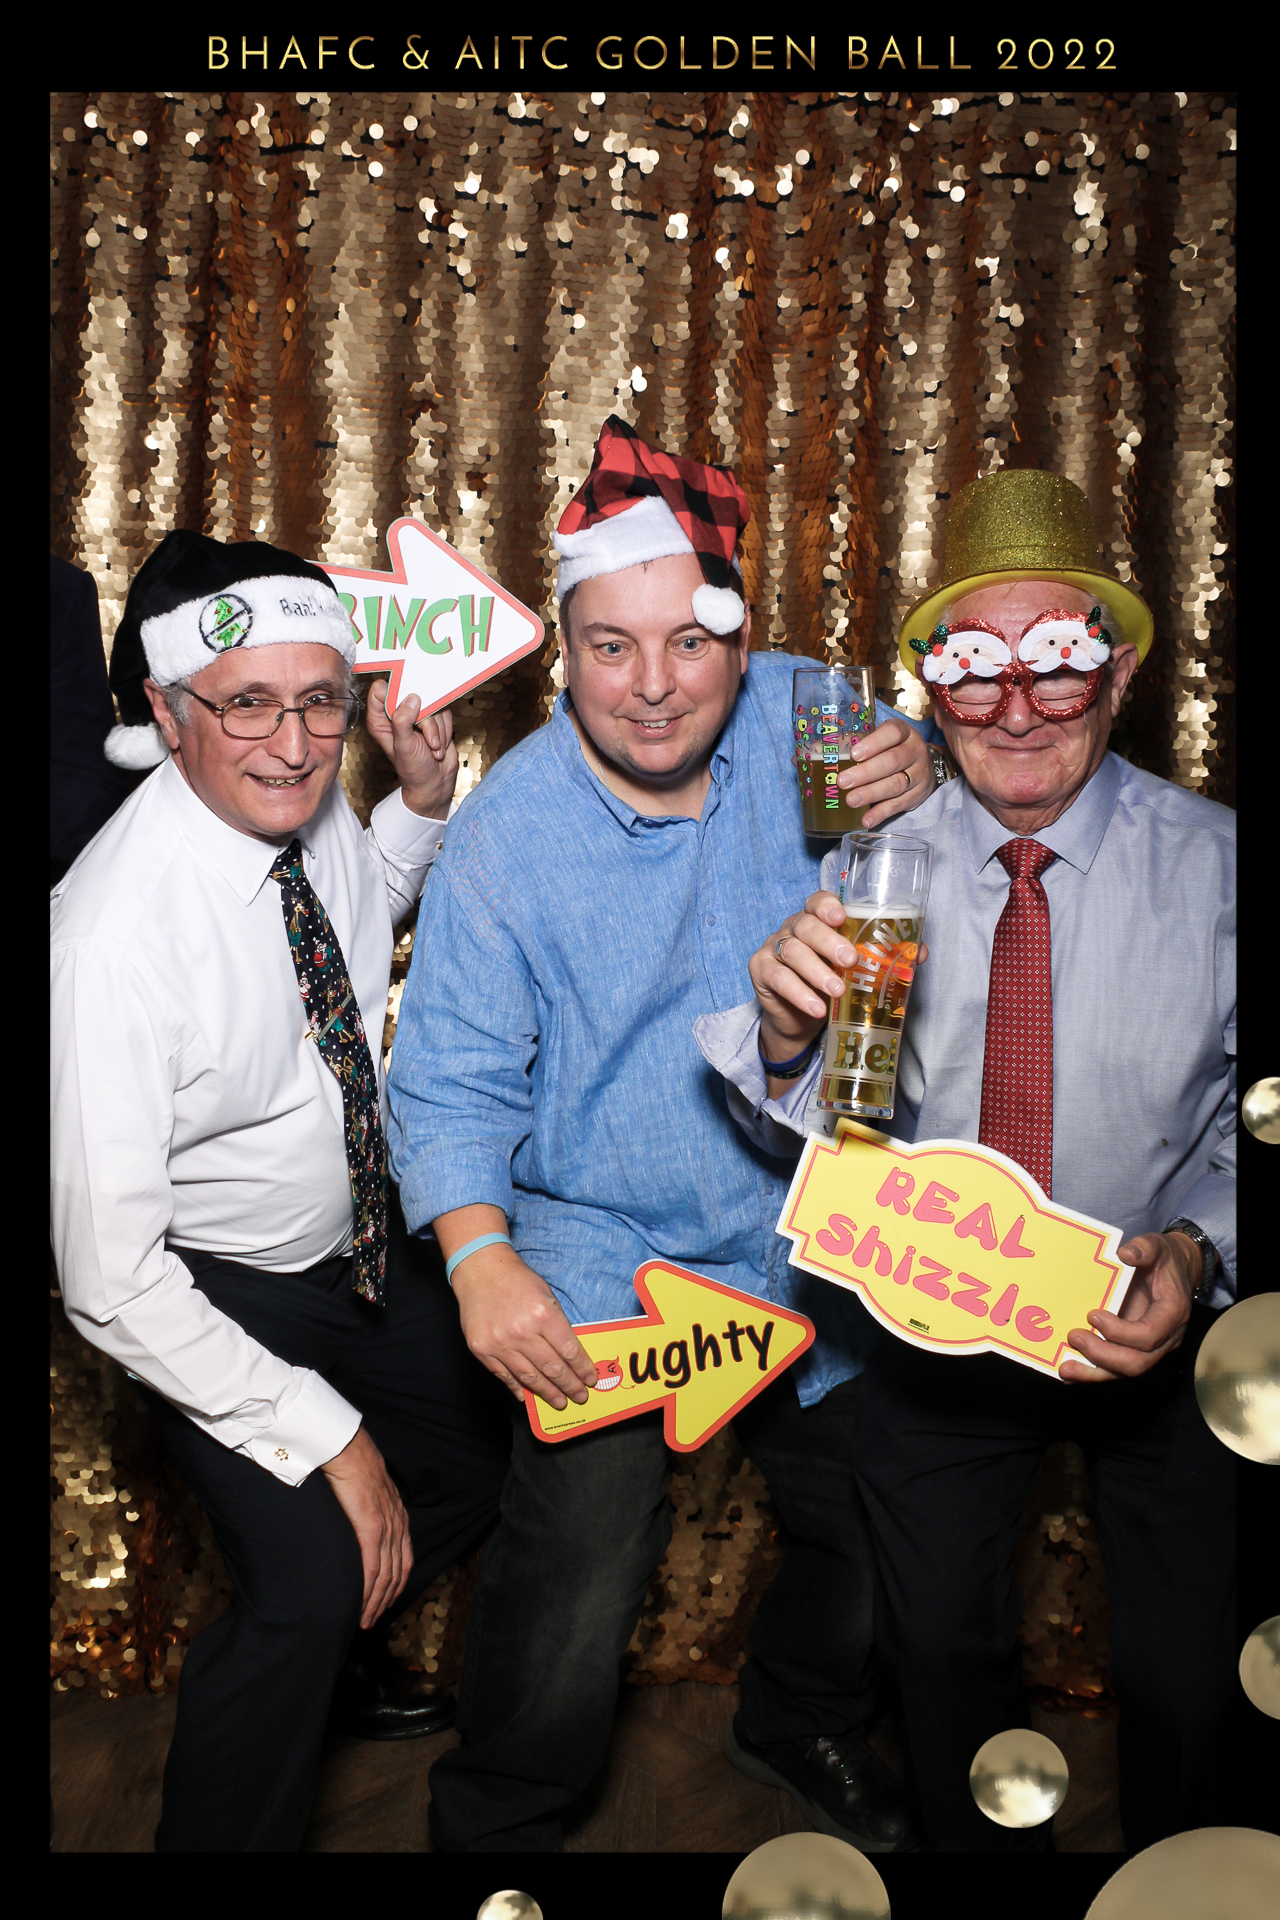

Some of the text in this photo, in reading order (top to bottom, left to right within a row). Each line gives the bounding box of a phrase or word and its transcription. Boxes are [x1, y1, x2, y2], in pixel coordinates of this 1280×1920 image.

[821, 704, 840, 810] BEAVERTOWN
[875, 1166, 1036, 1259] REAL
[815, 1213, 1054, 1343] Shizzle
